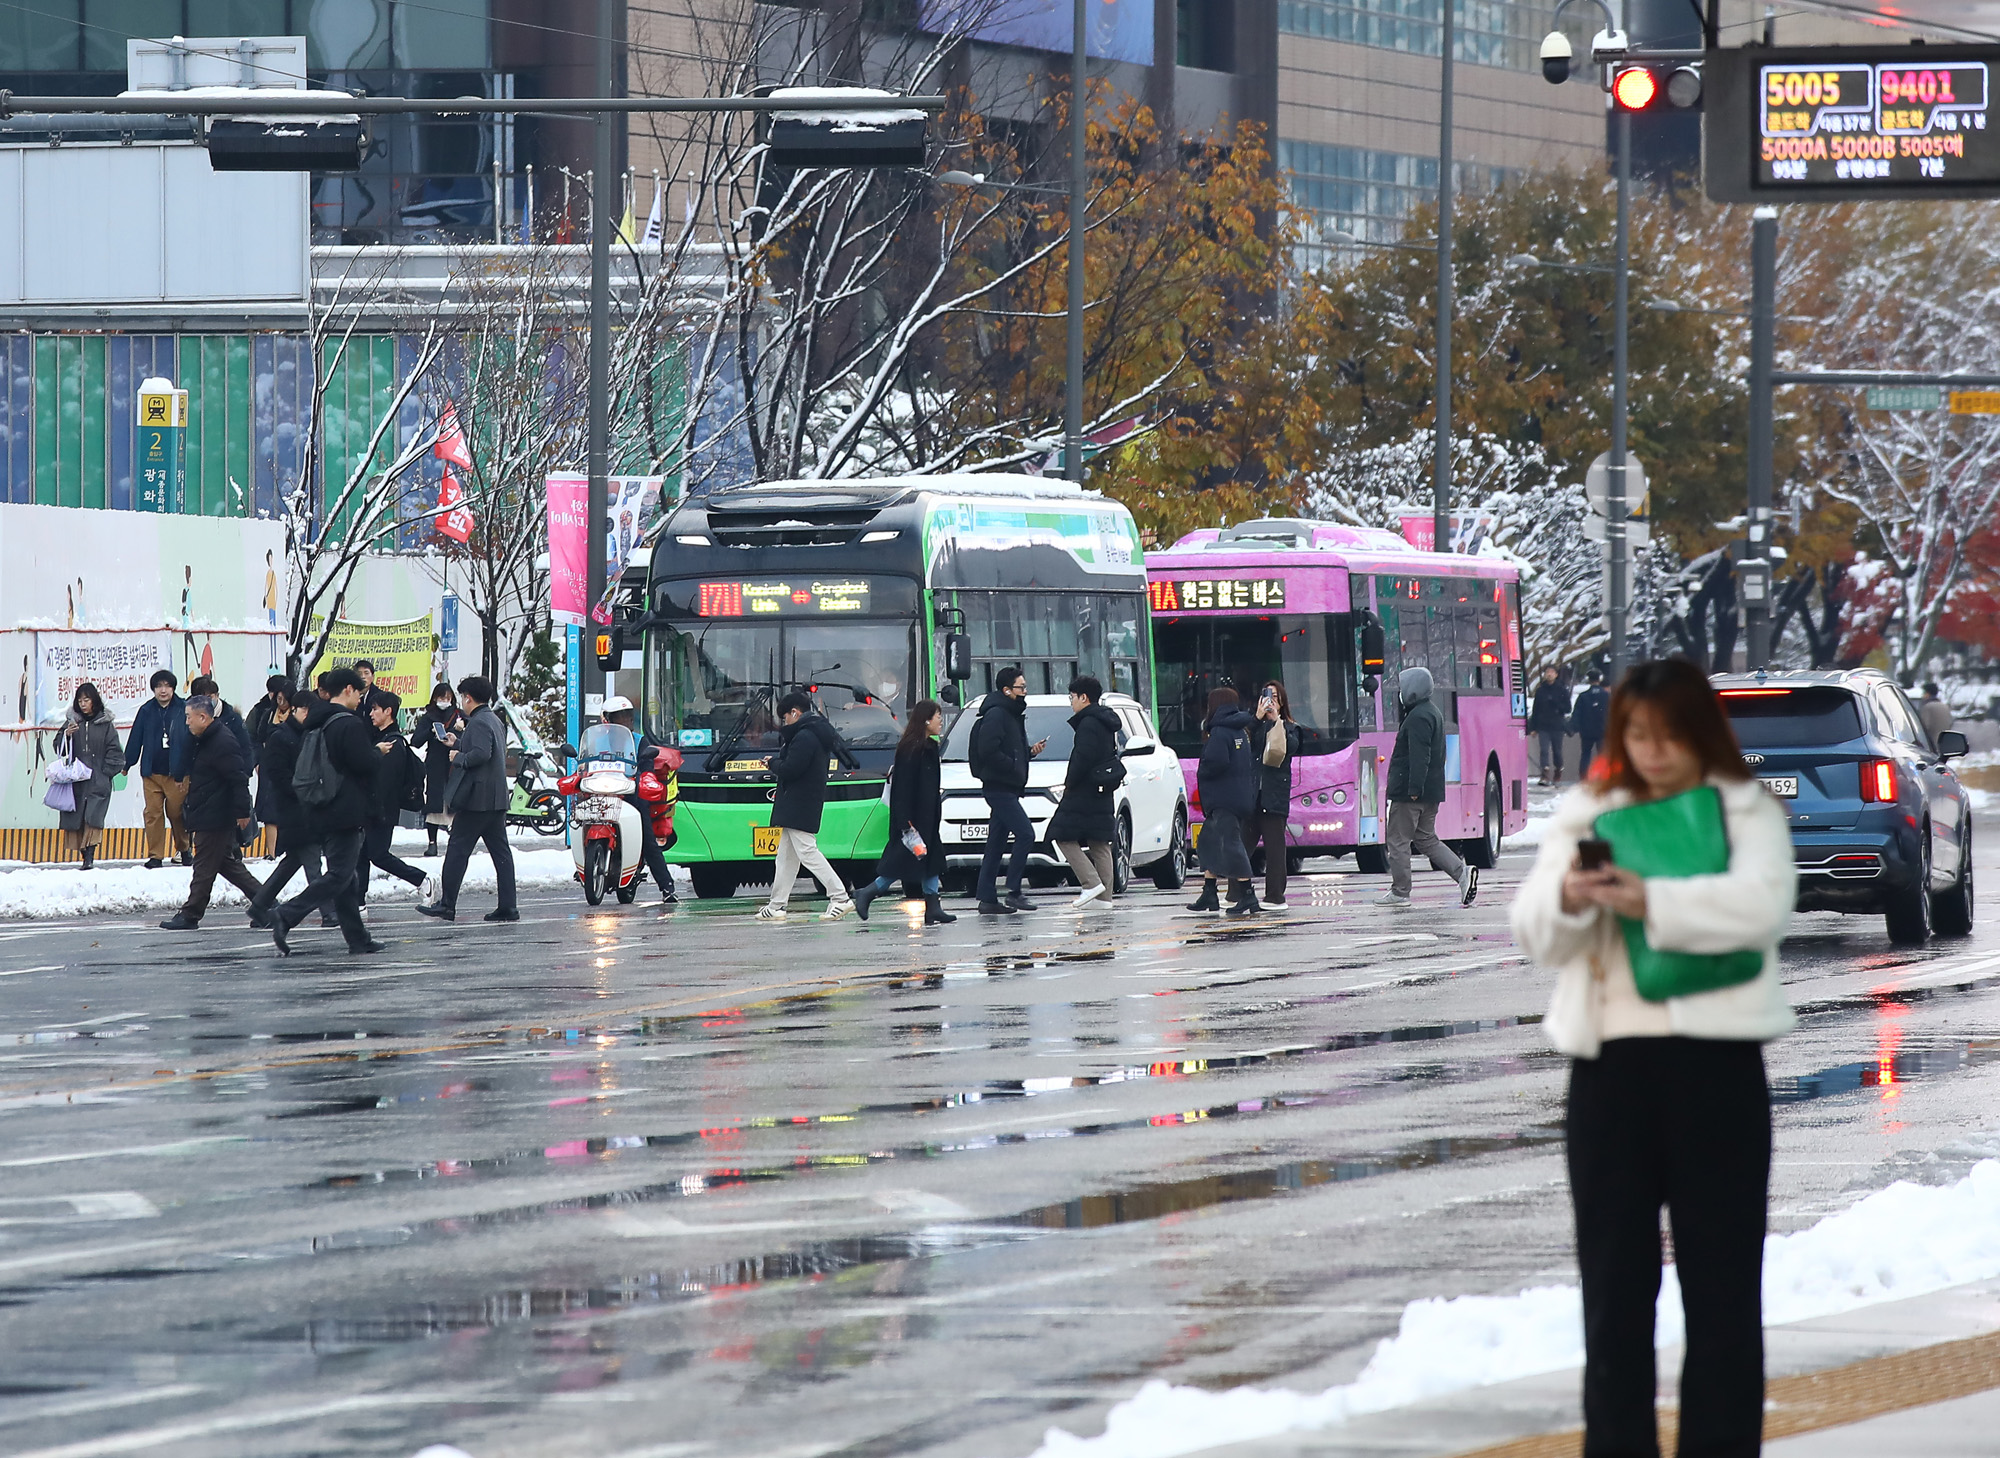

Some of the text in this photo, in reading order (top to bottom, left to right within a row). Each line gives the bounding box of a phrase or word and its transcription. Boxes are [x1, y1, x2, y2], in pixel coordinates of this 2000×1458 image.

[1767, 73, 1840, 106] 5005
[1881, 70, 1955, 104] 9401
[1881, 110, 1925, 130] 곧도착
[1761, 136, 1829, 161] 5000A
[1830, 135, 1897, 160] 5000B
[150, 432, 162, 450] 2
[819, 596, 861, 611] Station
[1148, 579, 1284, 611] 1A 현금 없는 버스
[120, 673, 147, 699] 죄송합니다
[592, 761, 622, 771] 공무수행
[726, 762, 748, 770] 우리는
[1744, 756, 1761, 764] KIA
[767, 829, 781, 837] 서울
